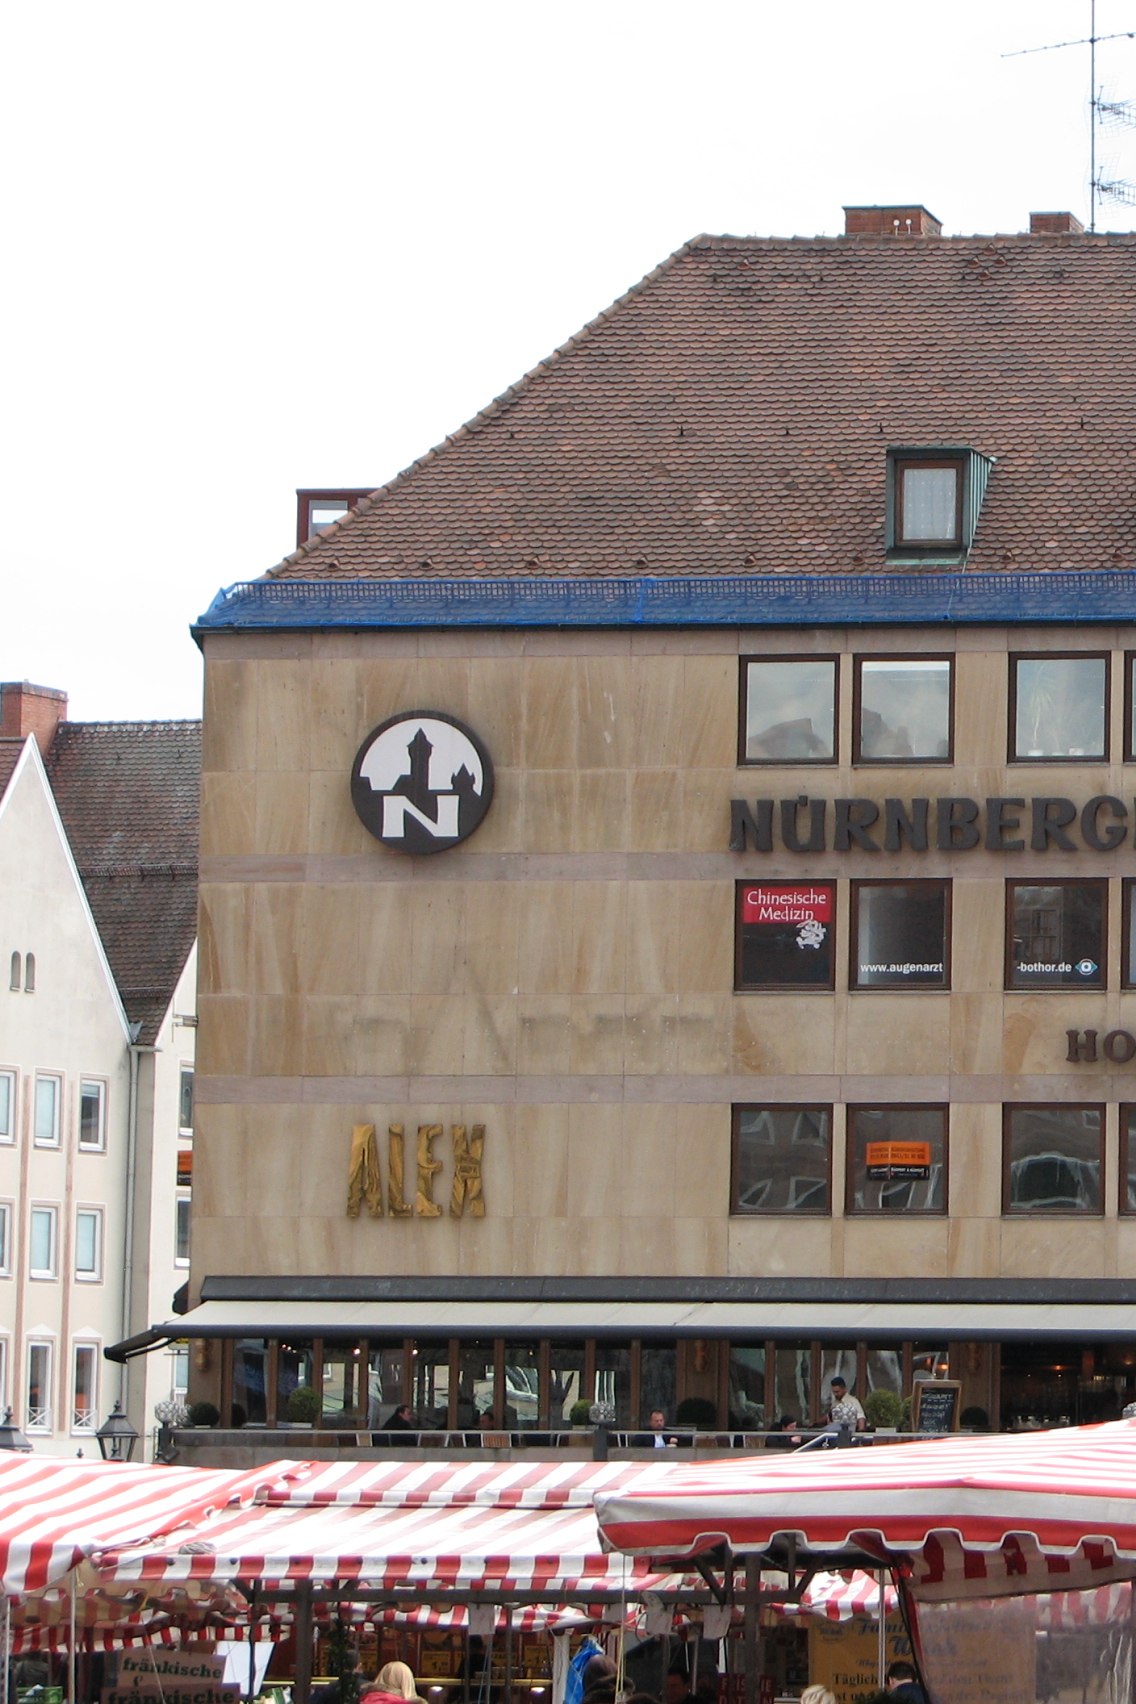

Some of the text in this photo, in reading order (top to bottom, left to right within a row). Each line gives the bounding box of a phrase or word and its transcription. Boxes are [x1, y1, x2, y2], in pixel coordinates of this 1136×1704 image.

[747, 889, 826, 905] Chinesische
[759, 906, 814, 921] Medizin
[860, 962, 1072, 975] www.augenarzt -bothor.de
[346, 1123, 487, 1218] ALEX
[122, 1658, 222, 1679] fränkische
